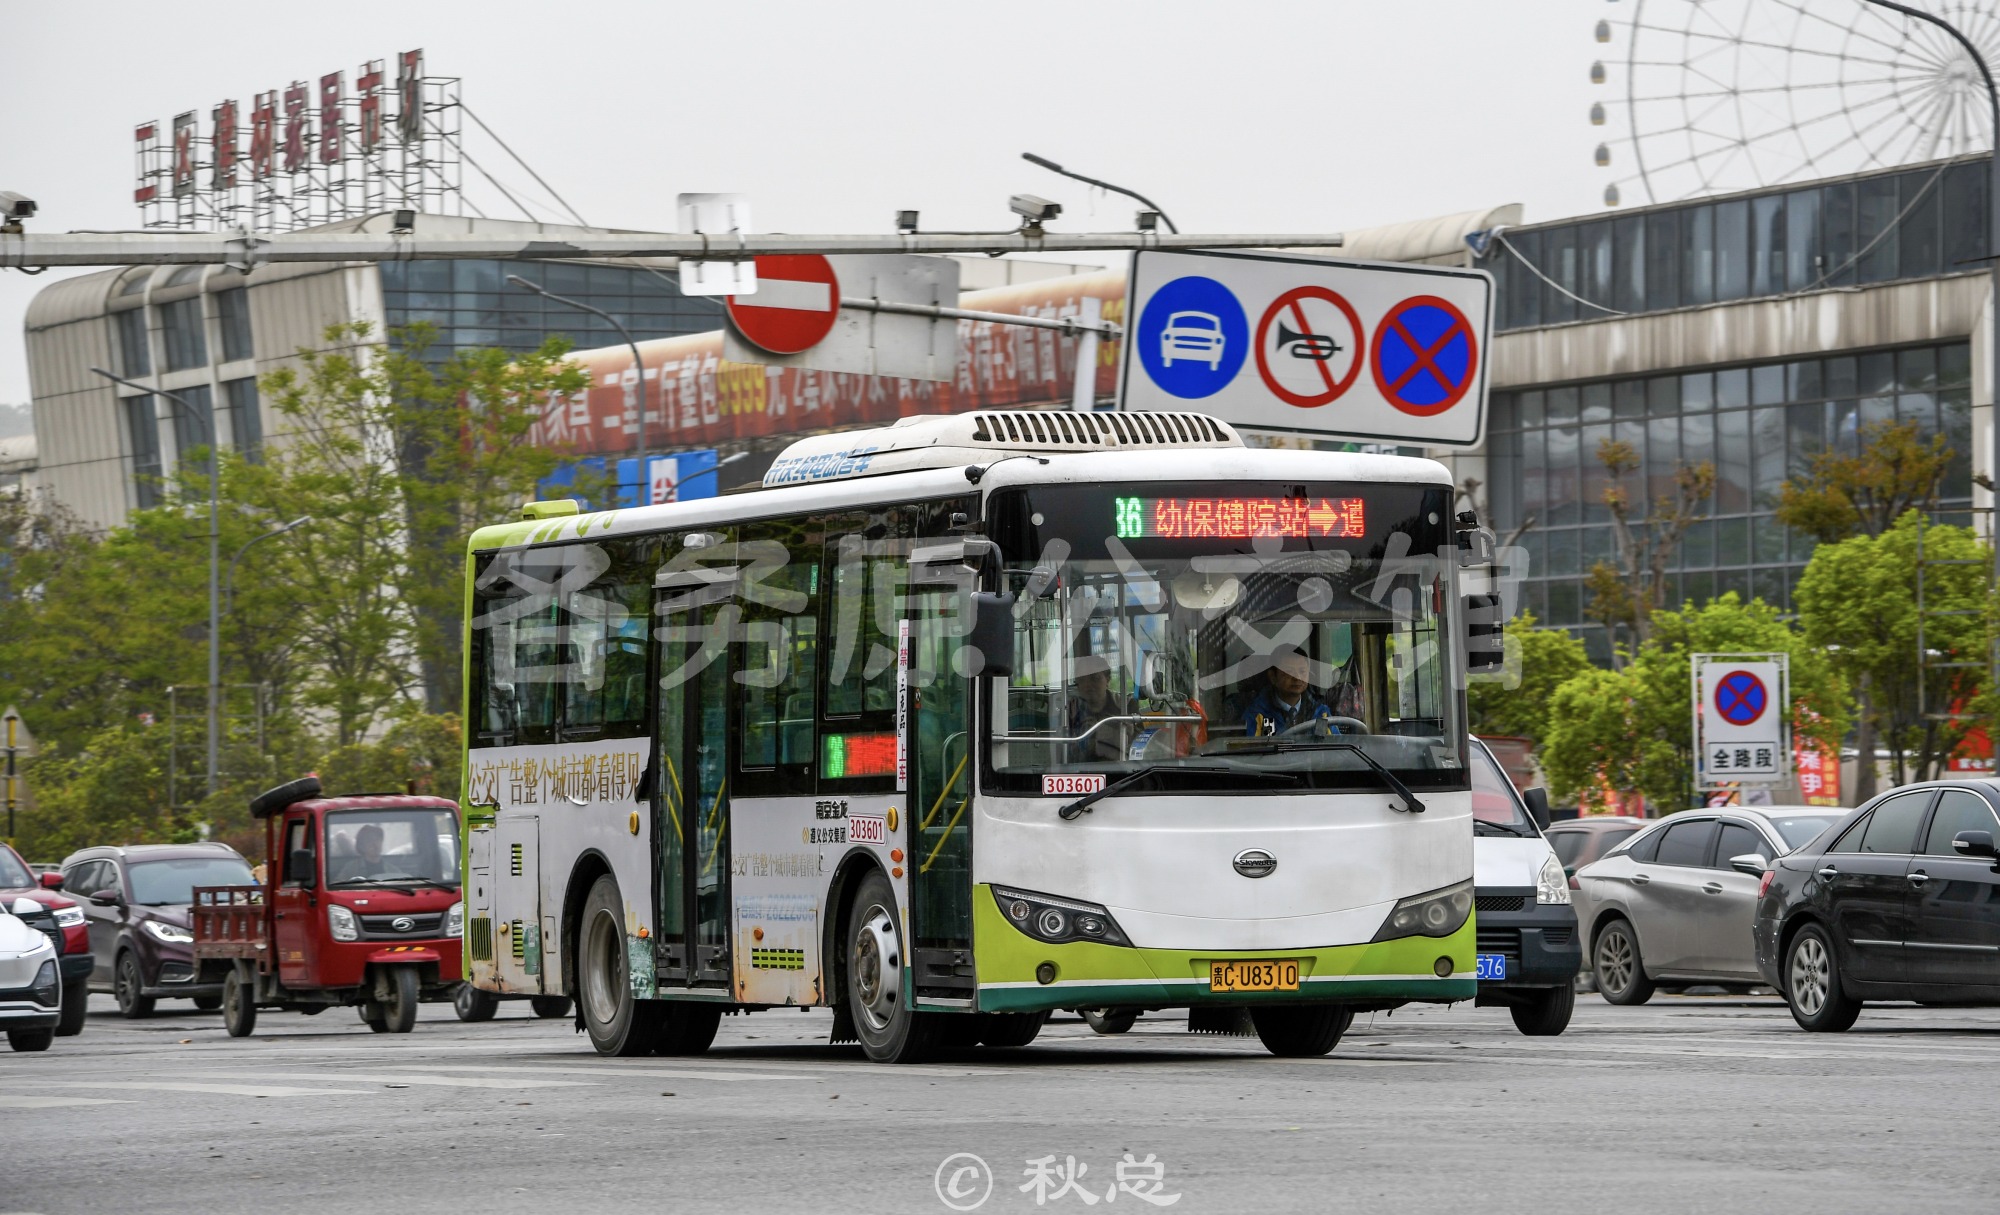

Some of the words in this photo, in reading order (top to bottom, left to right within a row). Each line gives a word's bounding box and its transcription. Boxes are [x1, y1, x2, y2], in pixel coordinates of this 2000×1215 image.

[1714, 749, 1772, 768] 全路段
[469, 752, 640, 805] 公交广告整个城市都看得见
[1047, 777, 1101, 793] 303601
[816, 801, 849, 820] 南京金龙
[810, 828, 846, 844] 遵义公交集团
[850, 818, 883, 841] 303601
[1476, 958, 1503, 976] 576
